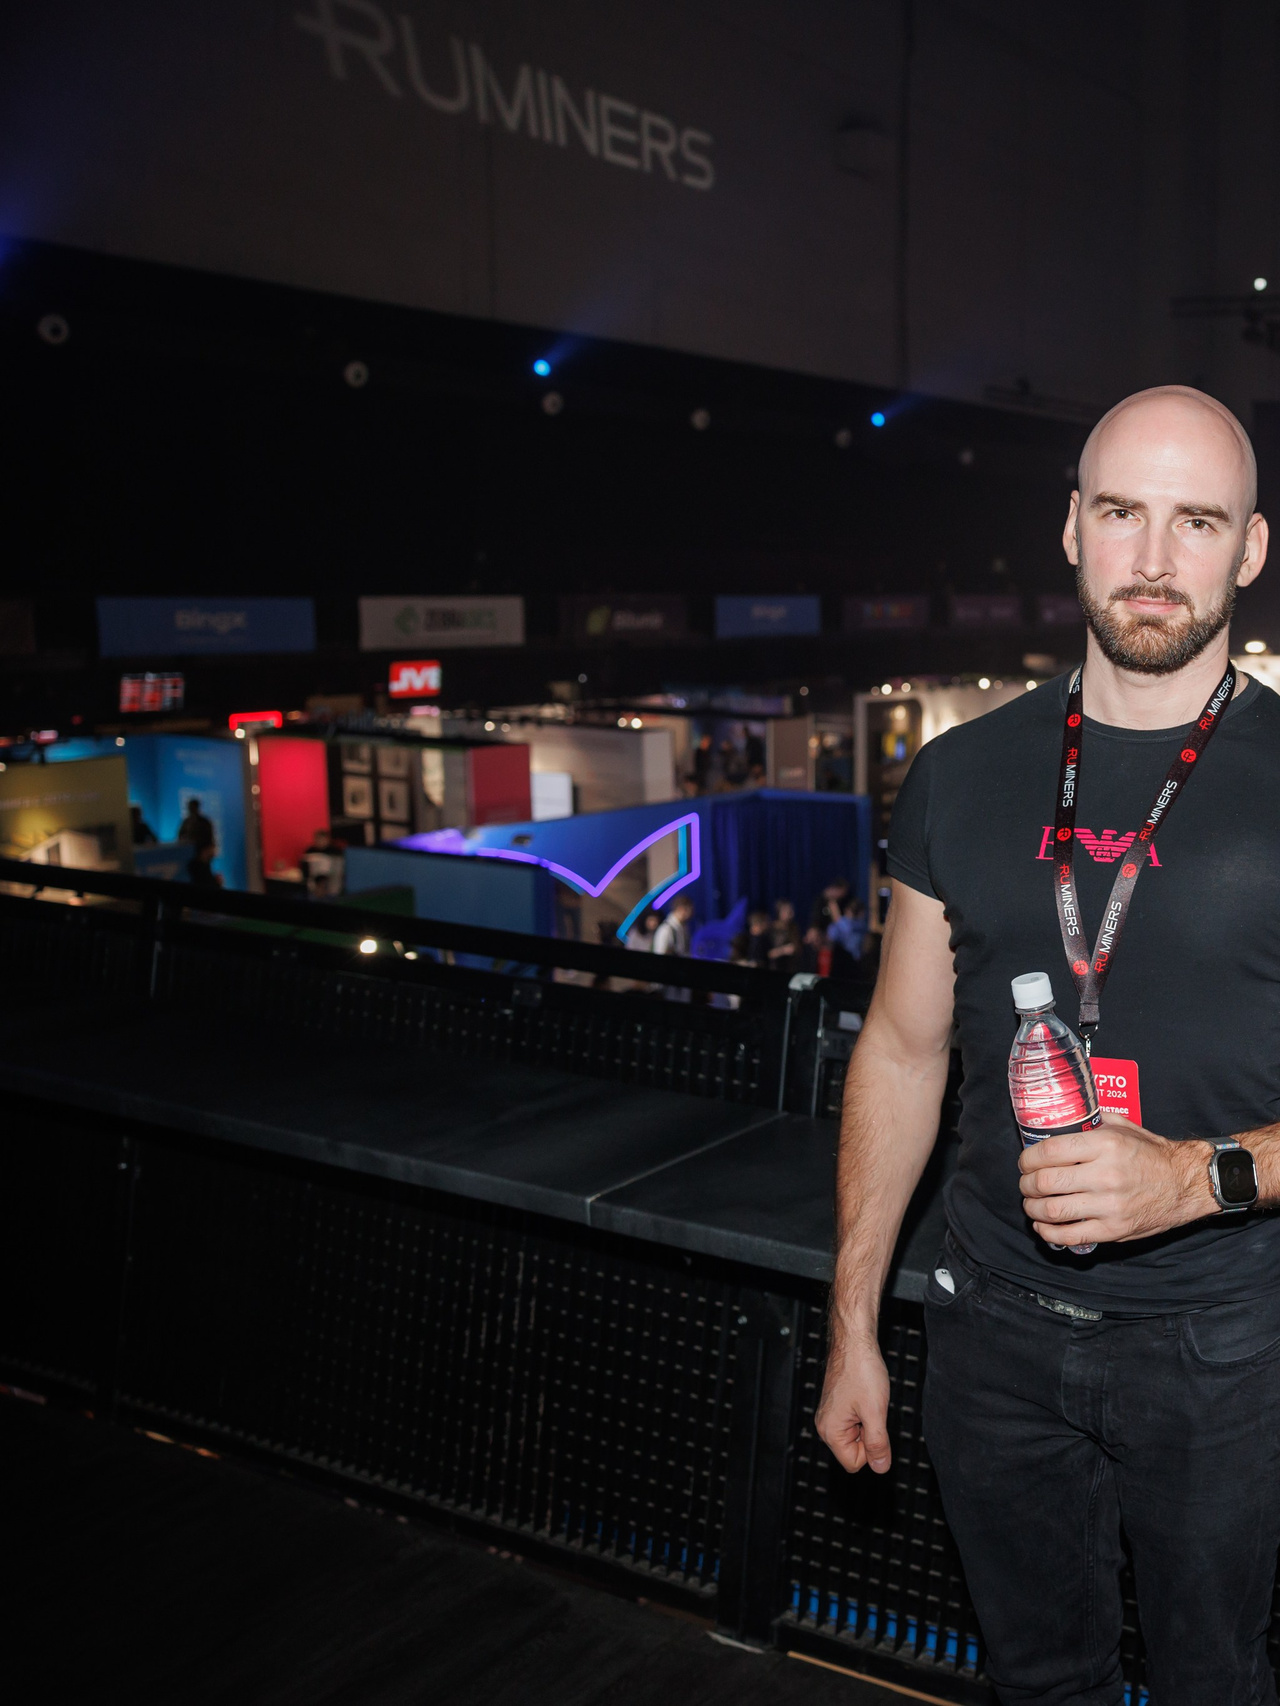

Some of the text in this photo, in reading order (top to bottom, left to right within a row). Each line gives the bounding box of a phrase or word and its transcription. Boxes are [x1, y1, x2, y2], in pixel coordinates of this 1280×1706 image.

[295, 0, 716, 191] RUMINERS
[1199, 673, 1234, 730] RUMINERS
[1062, 747, 1079, 807] RUMINERS
[1138, 780, 1178, 841] RUMINERS
[1059, 863, 1080, 936] RUMINERS
[1094, 900, 1123, 973] RUMINERS
[1106, 1089, 1128, 1099] 2024
